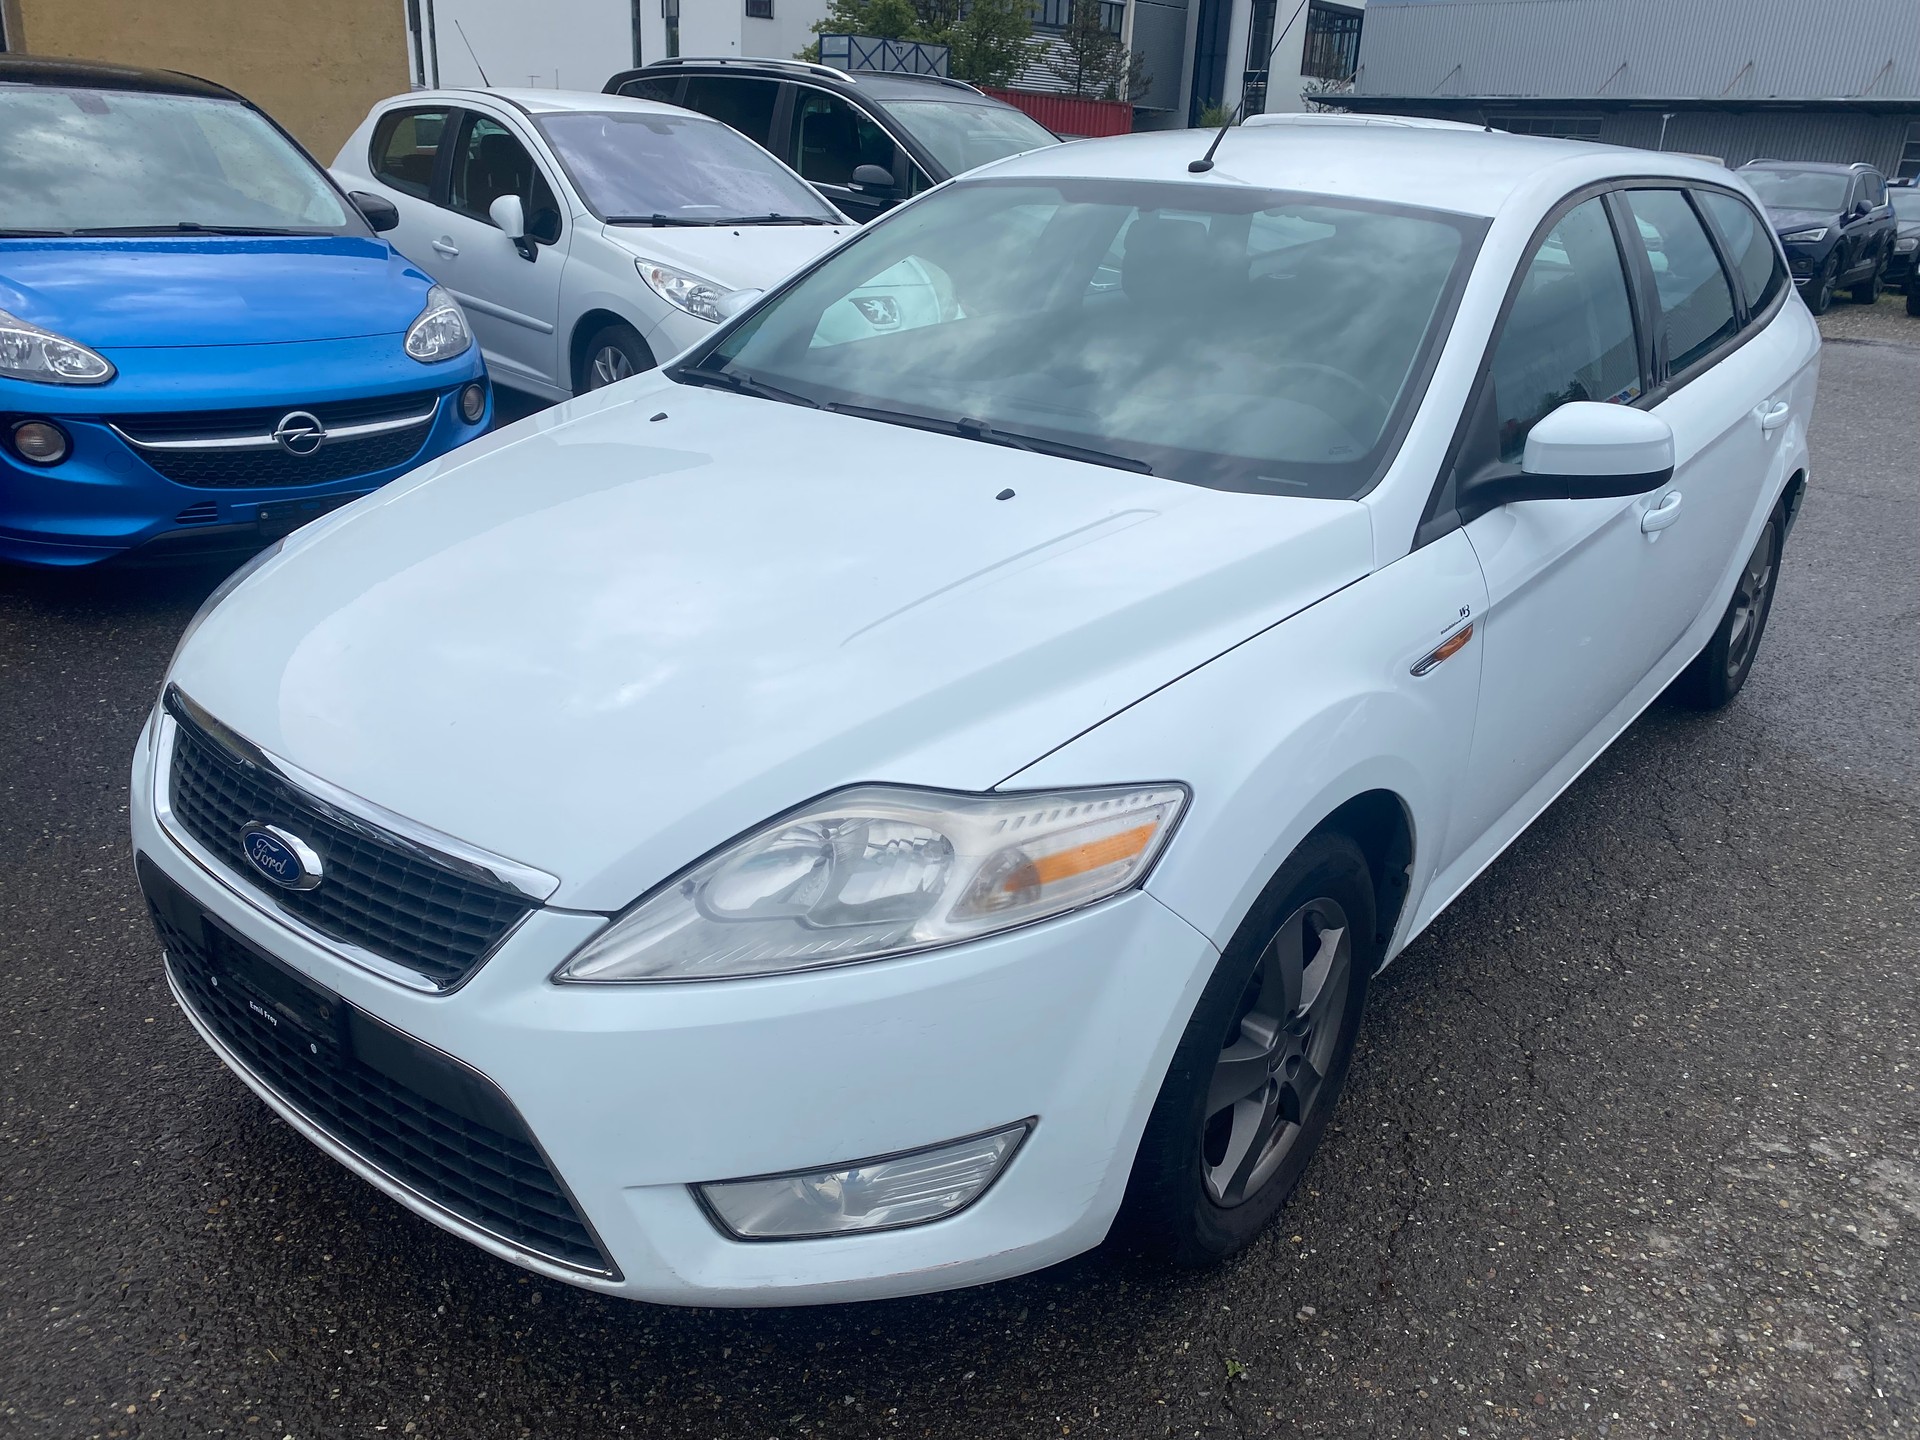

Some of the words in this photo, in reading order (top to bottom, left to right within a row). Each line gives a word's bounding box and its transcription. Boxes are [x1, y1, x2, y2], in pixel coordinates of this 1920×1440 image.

[252, 838, 287, 875] Ford
[249, 1000, 263, 1016] Emil
[263, 1010, 278, 1027] Frey
